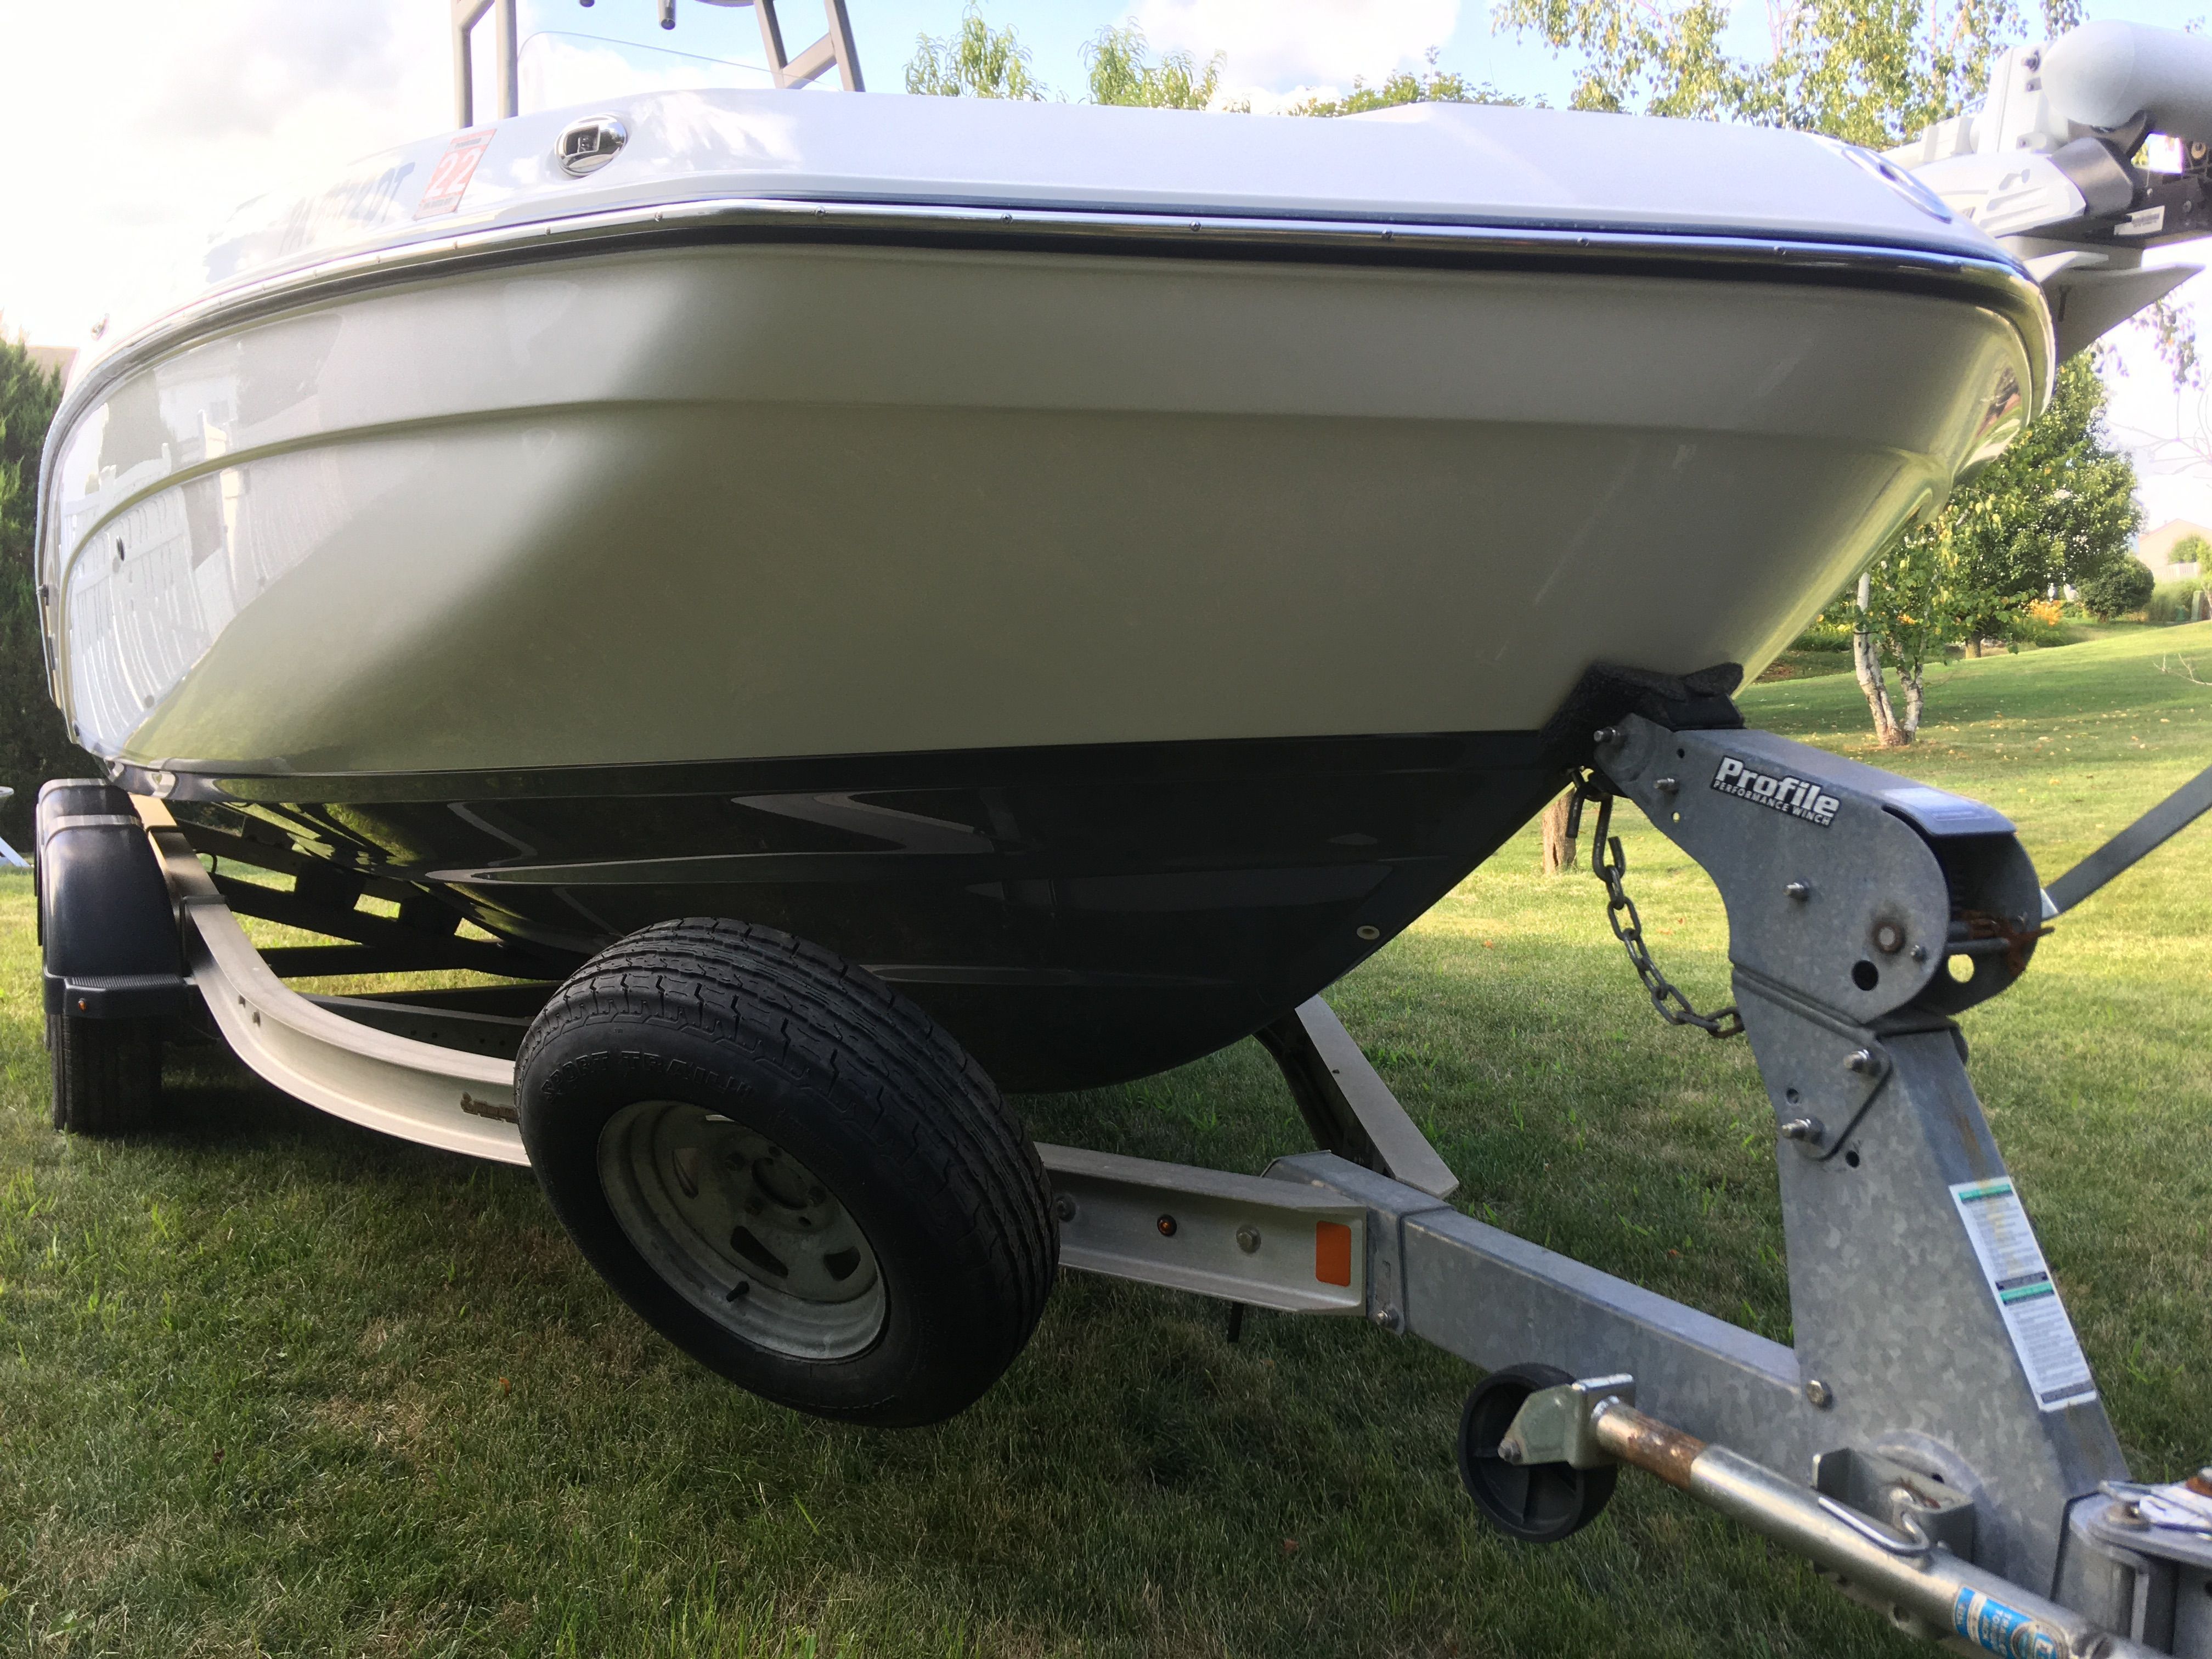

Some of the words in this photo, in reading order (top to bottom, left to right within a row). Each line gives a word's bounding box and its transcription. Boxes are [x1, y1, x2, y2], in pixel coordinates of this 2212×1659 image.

[424, 148, 481, 199] 22
[1713, 781, 1789, 811] PERFORMANCE
[1792, 806, 1832, 826] WINCH
[1716, 757, 1839, 817] Profile
[541, 1051, 610, 1103] SPORT
